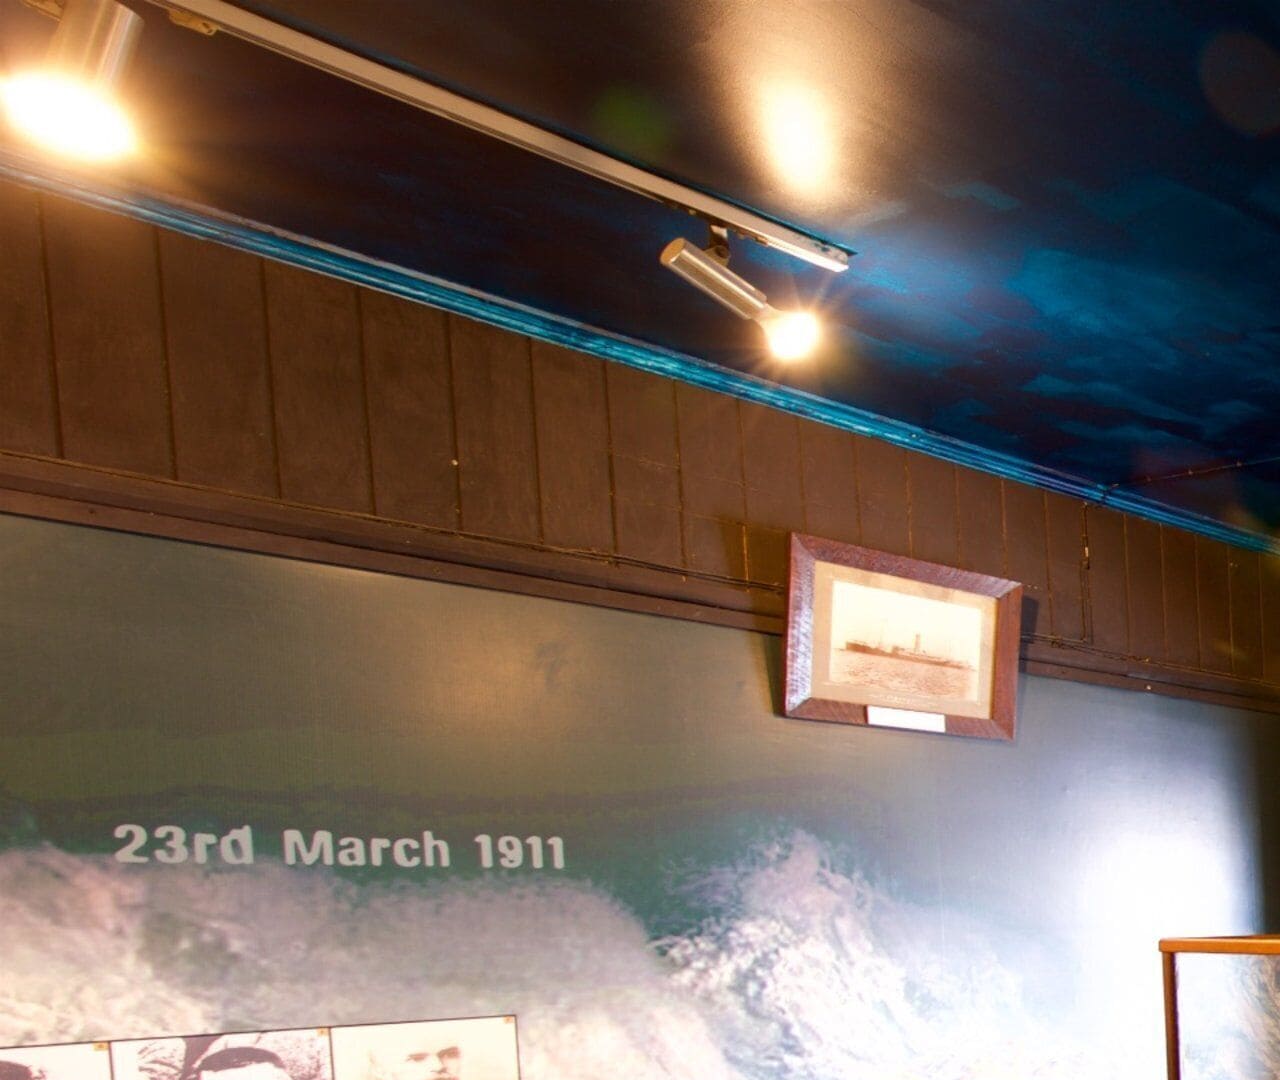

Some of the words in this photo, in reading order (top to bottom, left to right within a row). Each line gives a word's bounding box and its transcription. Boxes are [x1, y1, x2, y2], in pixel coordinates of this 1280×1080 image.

[113, 824, 254, 866] 23rd
[283, 829, 451, 869] March
[474, 834, 566, 870] 1911
